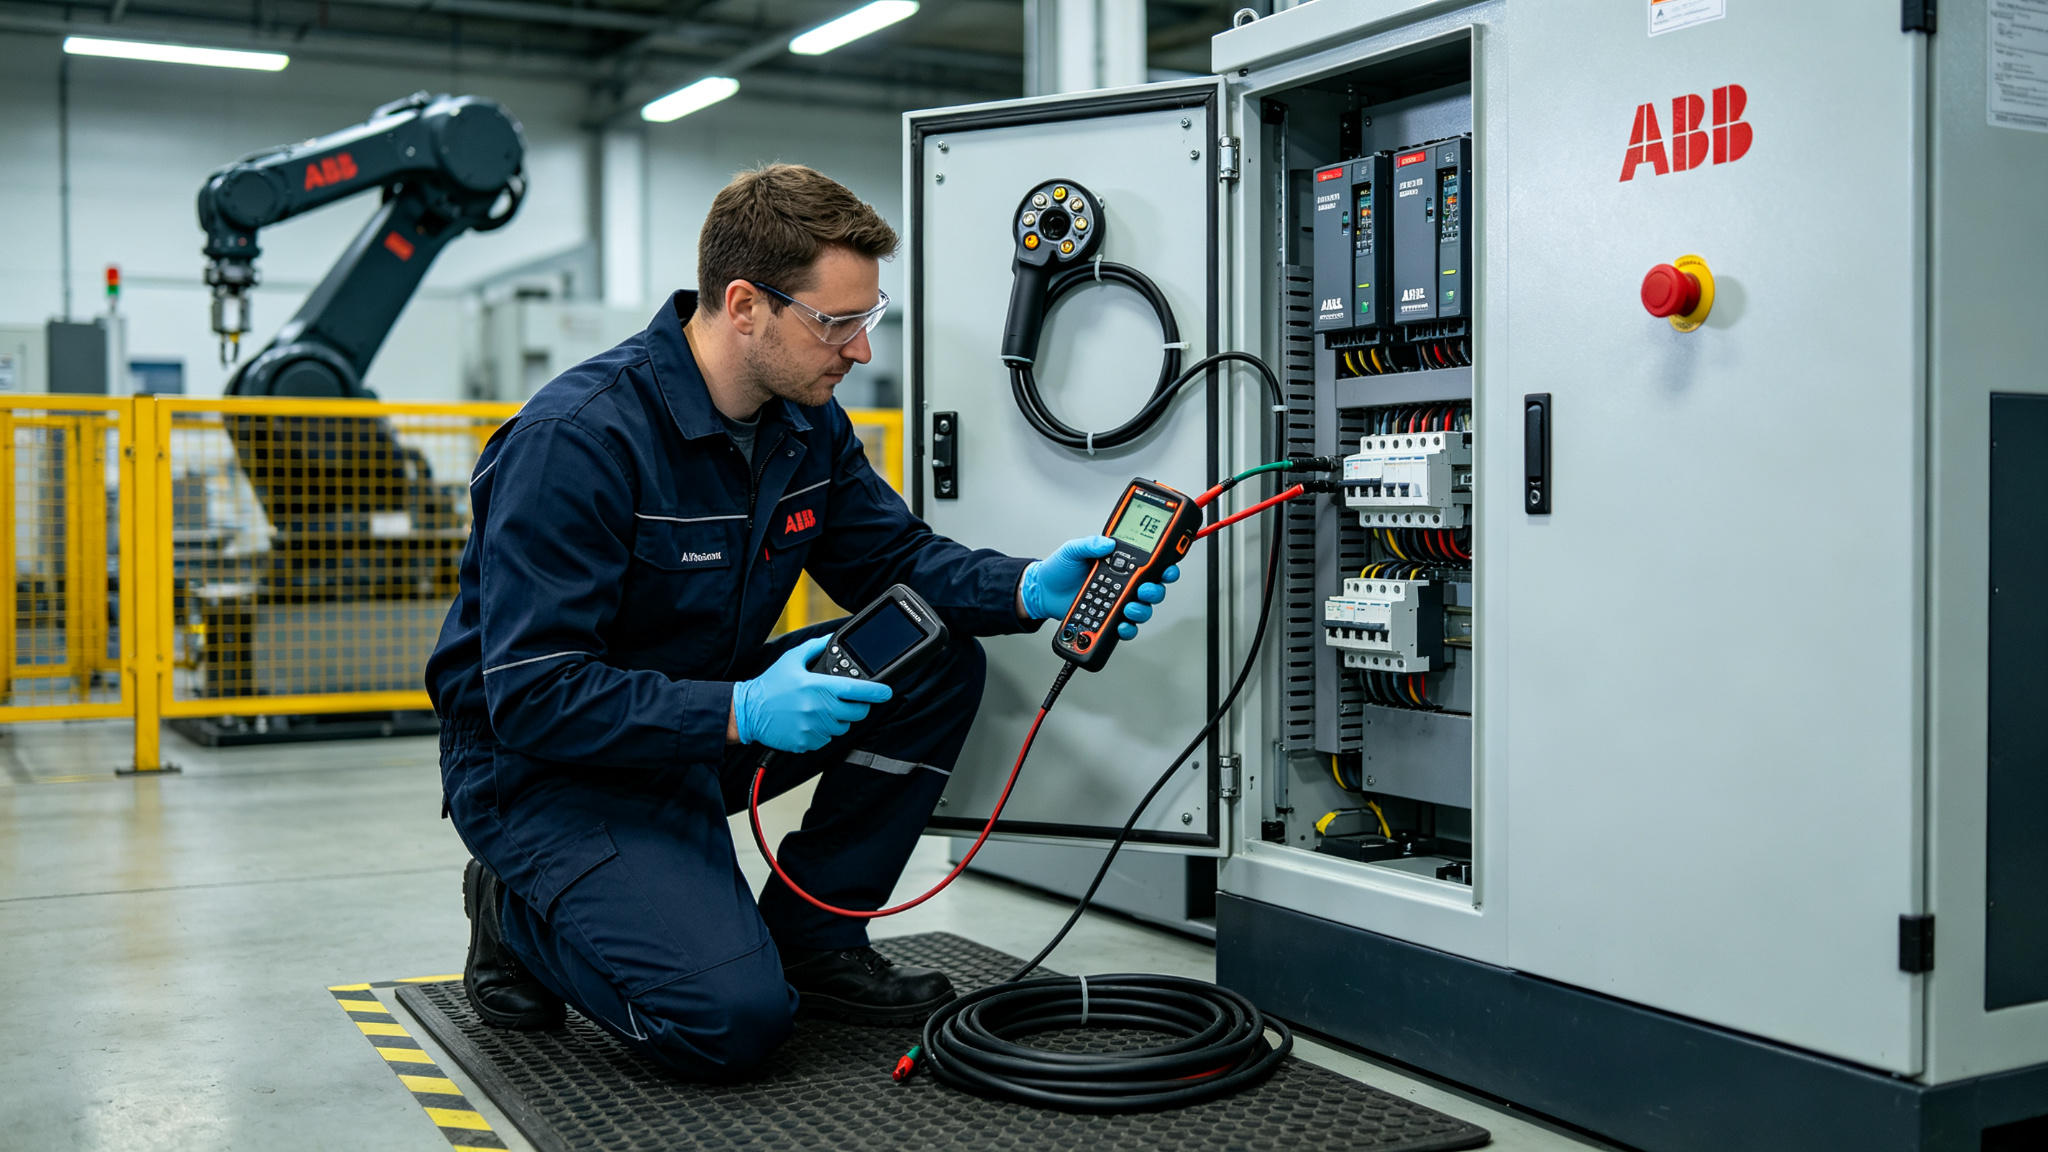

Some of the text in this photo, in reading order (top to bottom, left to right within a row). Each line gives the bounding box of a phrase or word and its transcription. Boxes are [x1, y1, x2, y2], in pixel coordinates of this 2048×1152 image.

[1619, 84, 1754, 182] ABB
[304, 152, 358, 192] ABB
[785, 509, 816, 535] ABB
